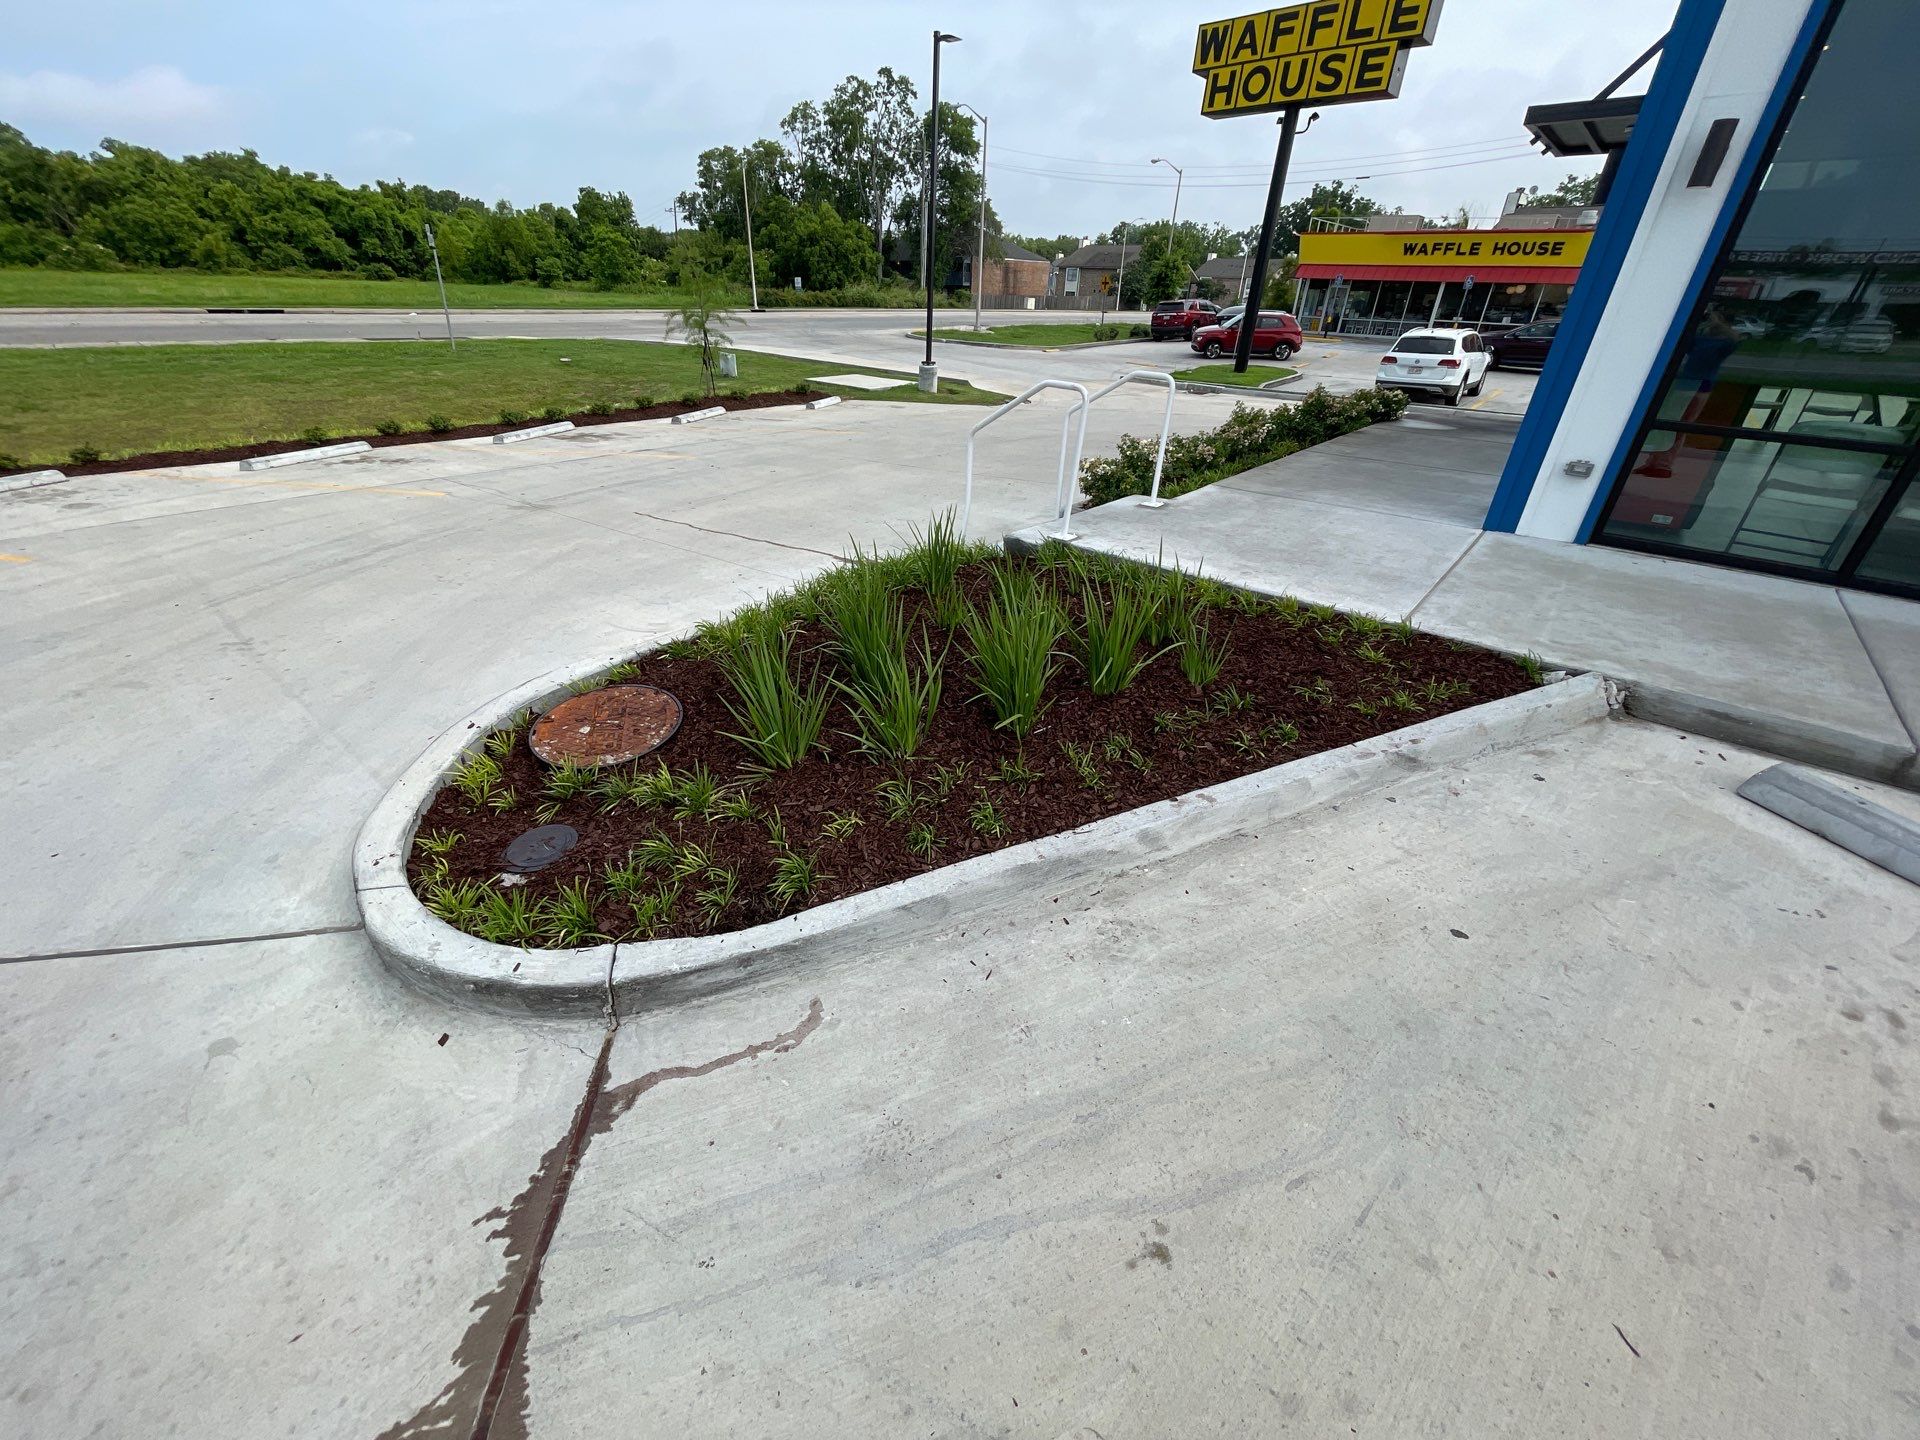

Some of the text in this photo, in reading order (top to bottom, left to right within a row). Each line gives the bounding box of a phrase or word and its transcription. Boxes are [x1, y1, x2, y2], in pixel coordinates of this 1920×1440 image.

[1200, 0, 1422, 65] WAFFLE
[1208, 46, 1390, 108] HOUSE
[1403, 241, 1566, 256] WAFFLE HOUSE
